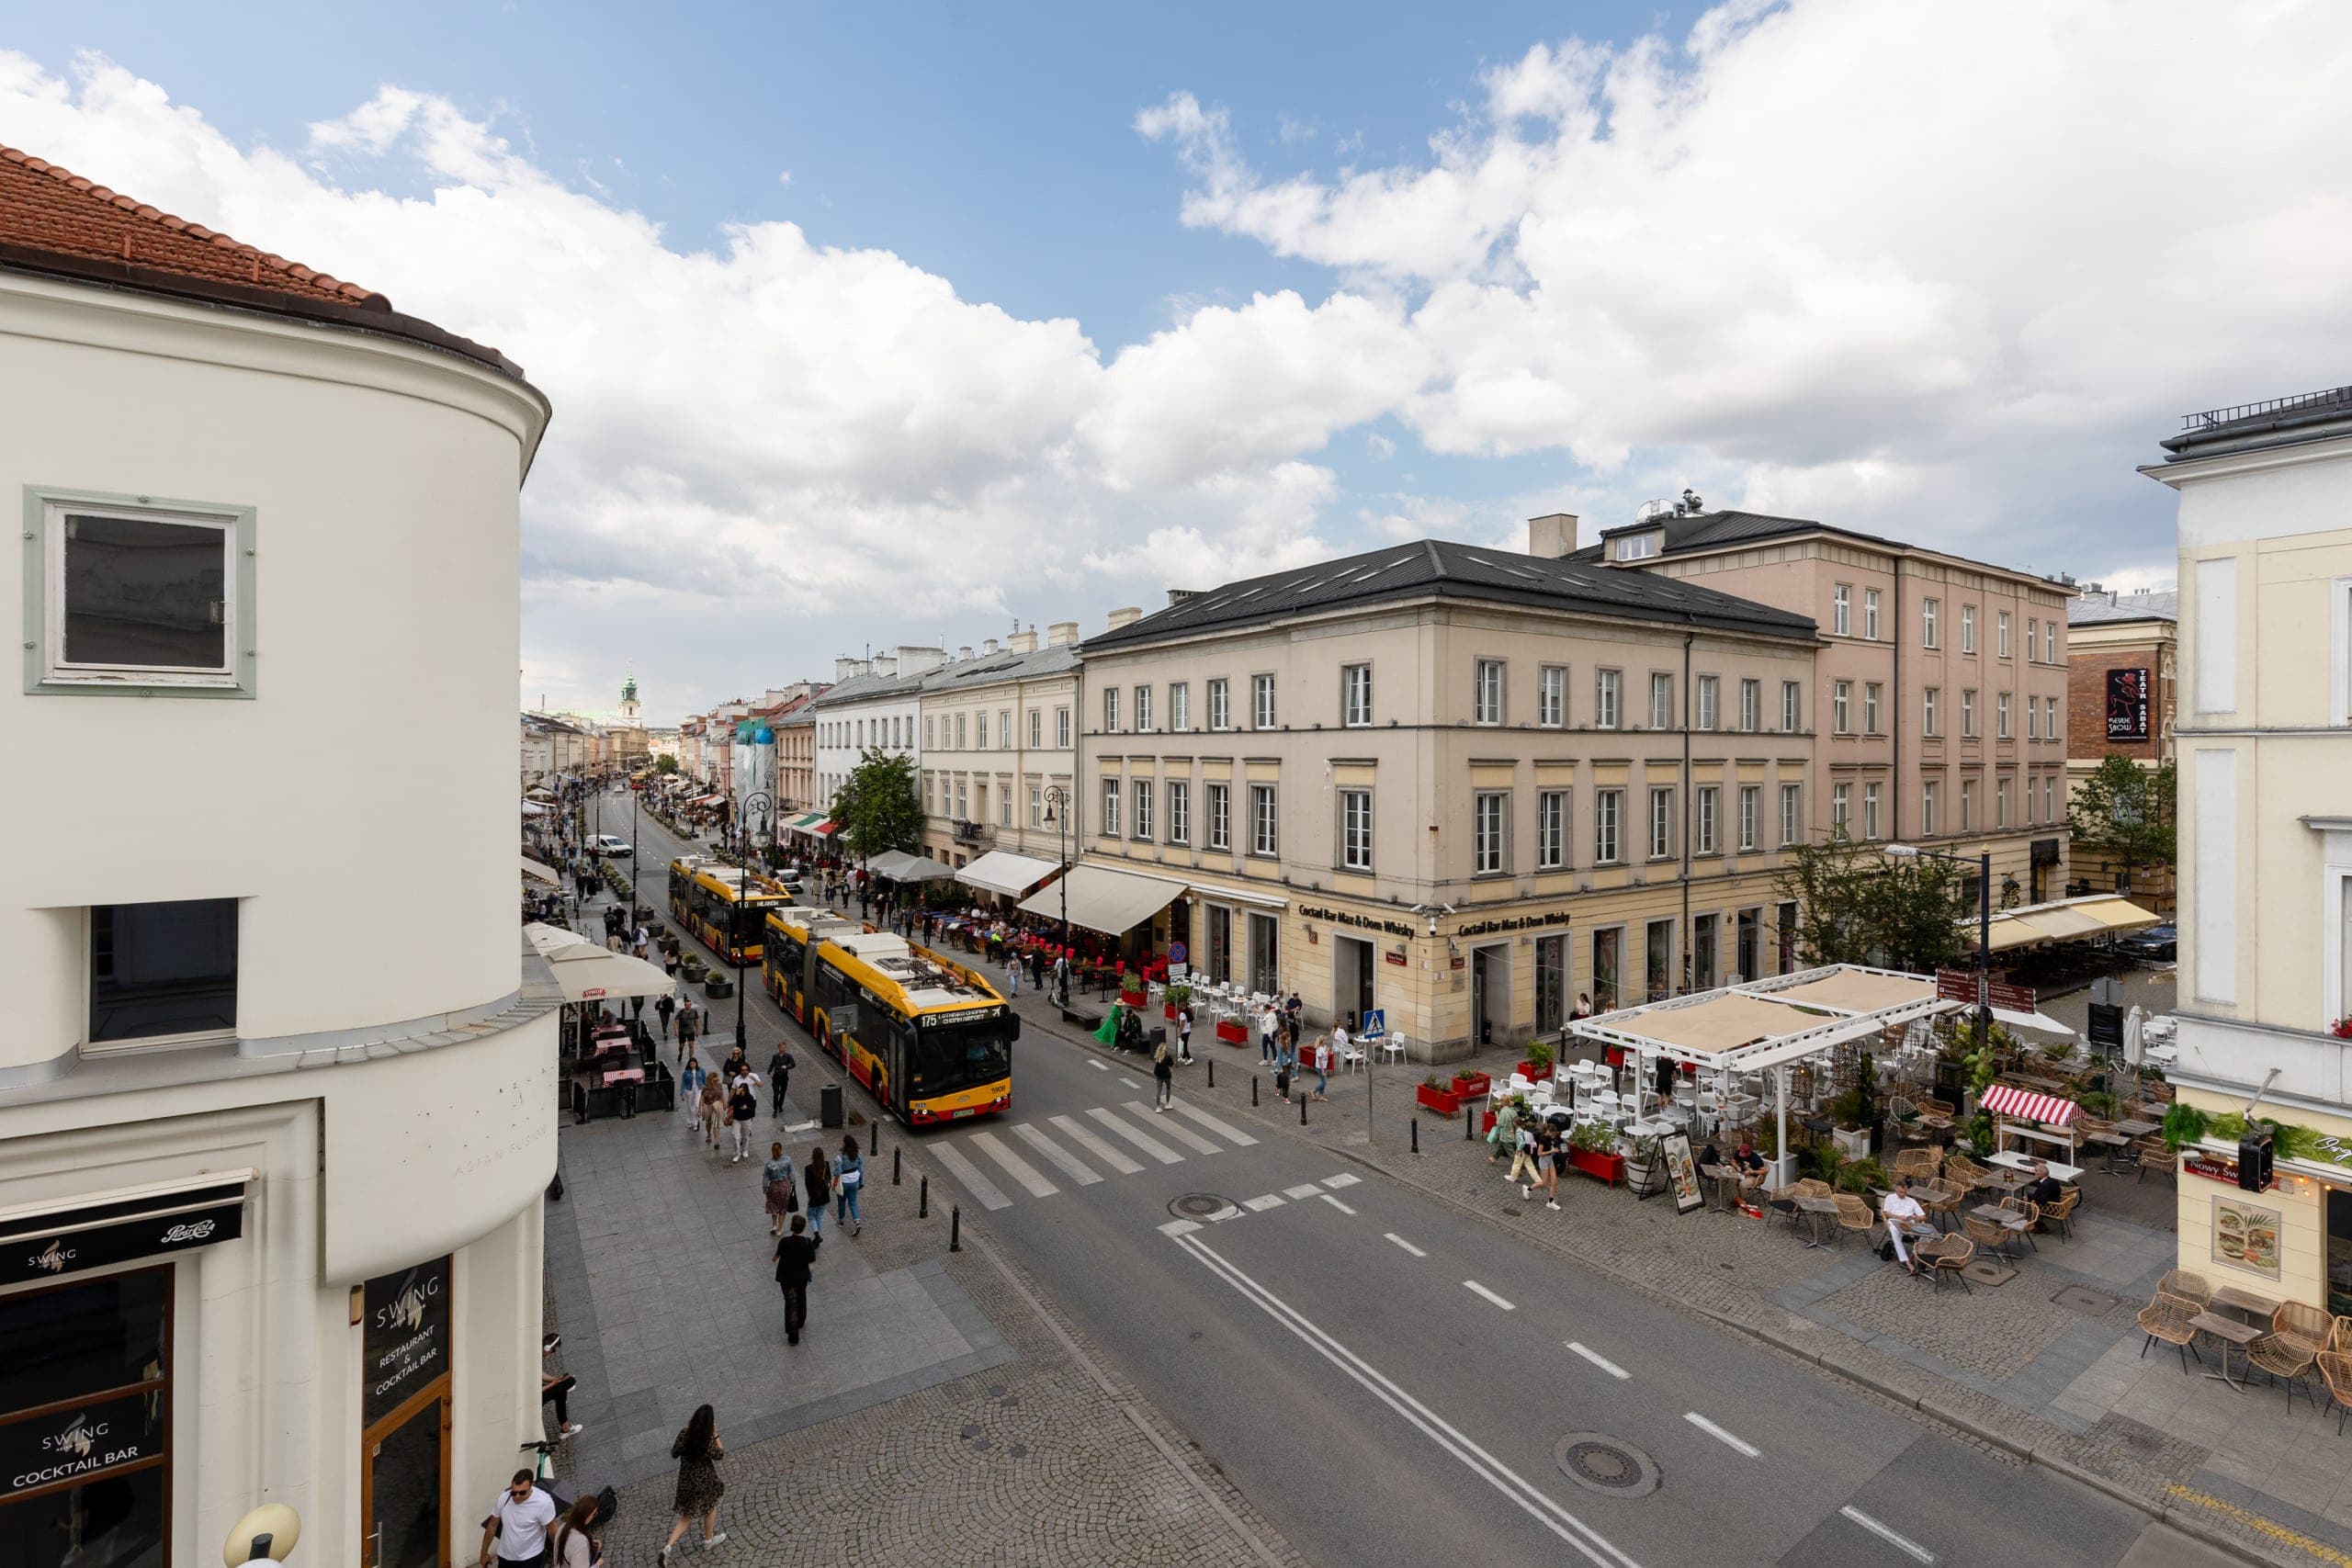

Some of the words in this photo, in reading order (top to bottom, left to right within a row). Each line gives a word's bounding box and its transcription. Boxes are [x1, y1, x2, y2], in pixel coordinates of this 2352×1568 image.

[2139, 670, 2147, 699] TEATR
[2139, 704, 2147, 734] SABAT
[1324, 908, 1337, 921] Bar
[1338, 911, 1354, 925] Max
[1354, 915, 1363, 927] &
[1363, 917, 1383, 931] Dom
[1384, 919, 1415, 941] Whisky
[1487, 920, 1500, 933] Bar
[1501, 919, 1518, 931] Max
[1519, 917, 1526, 930] &
[1544, 911, 1570, 926] Whisky
[922, 1014, 937, 1028] 175
[2190, 1160, 2220, 1176] Nowy
[28, 1248, 76, 1267] SWING
[376, 1276, 439, 1328] SWING
[379, 1325, 435, 1369] RESTAURANT
[403, 1353, 412, 1365] &
[375, 1361, 419, 1396] COCKTAIL
[420, 1347, 438, 1367] BAR
[41, 1422, 109, 1450] SWING
[12, 1456, 102, 1488] COCKTAIL
[105, 1446, 139, 1465] BAR
